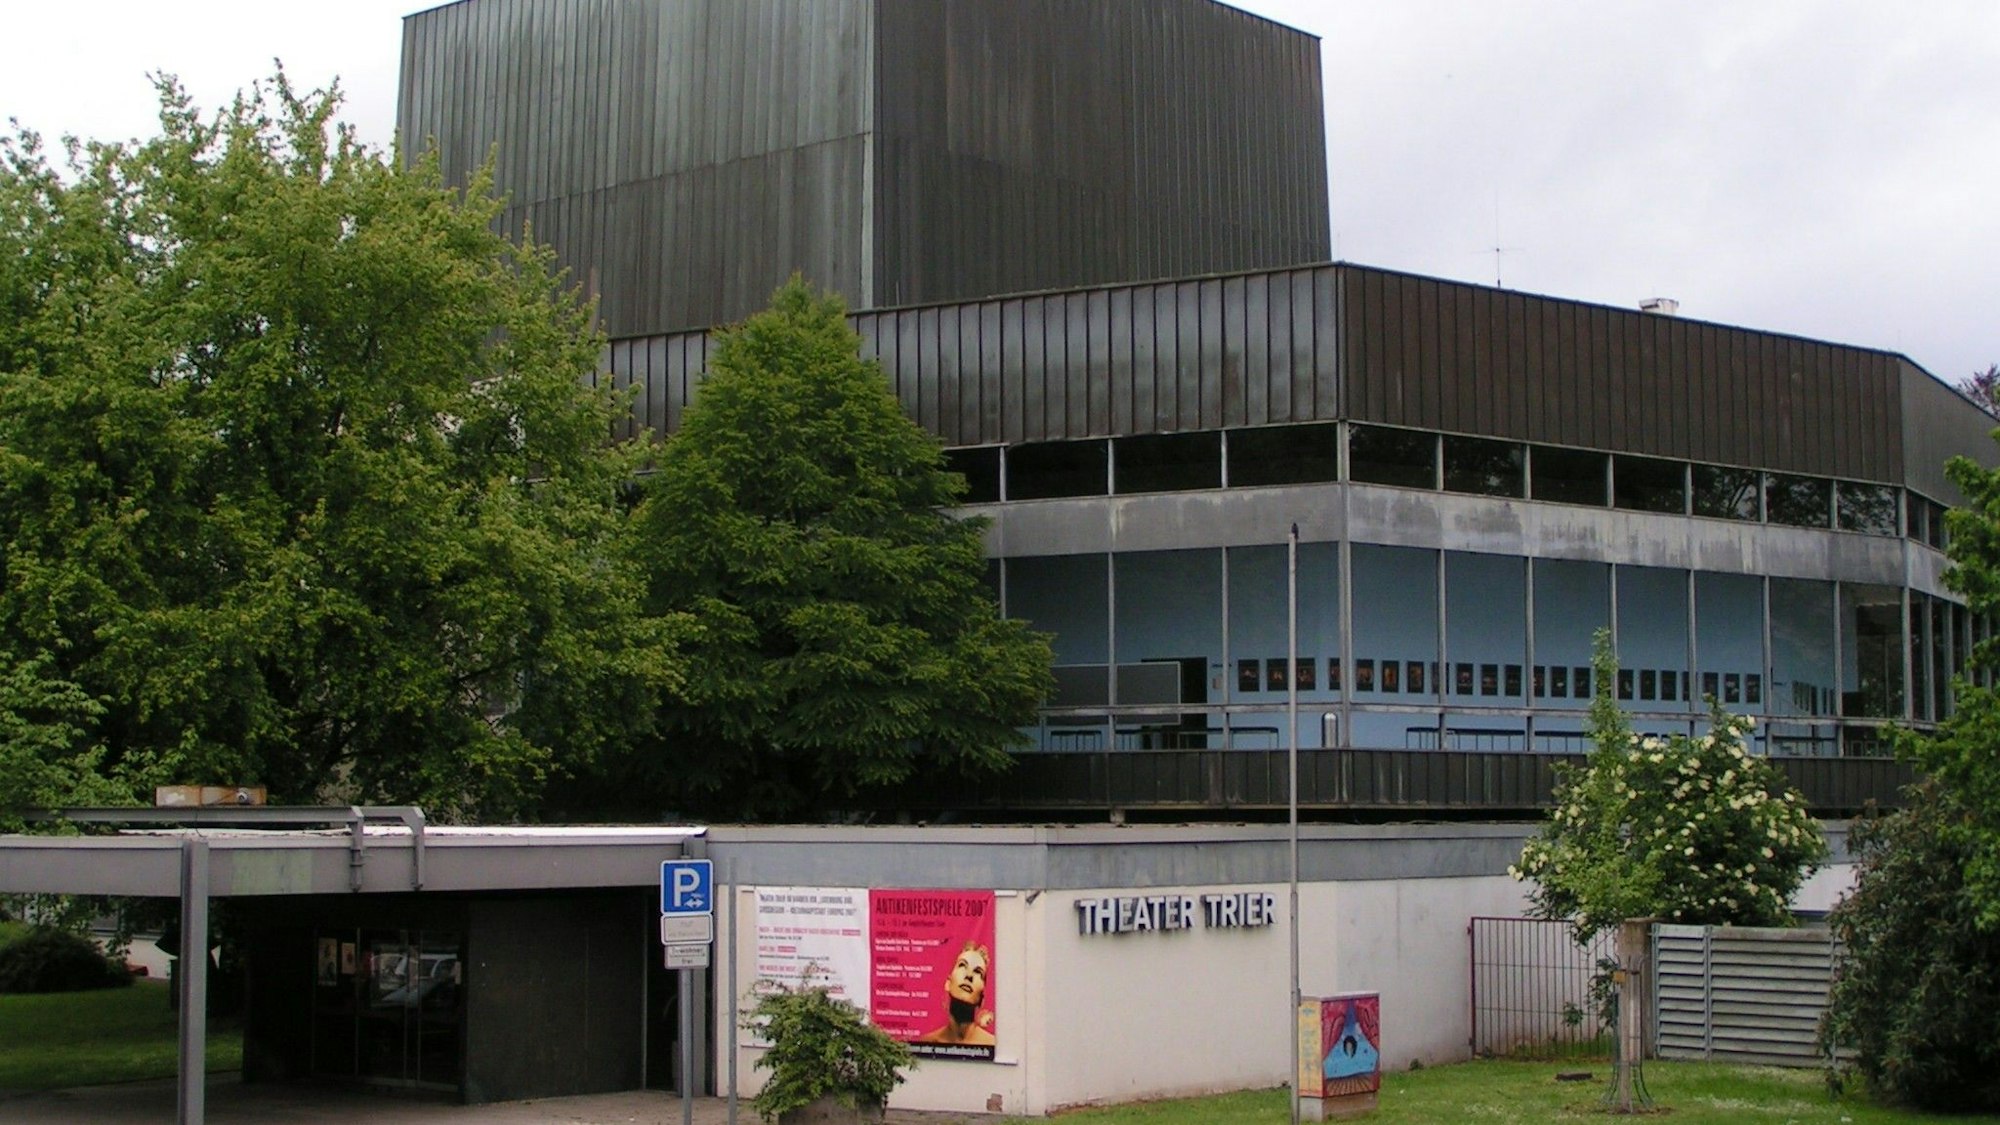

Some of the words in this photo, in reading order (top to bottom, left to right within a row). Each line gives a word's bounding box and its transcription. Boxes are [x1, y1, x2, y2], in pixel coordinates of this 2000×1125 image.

[674, 868, 700, 907] P
[876, 898, 962, 916] ANTIKENFESTSPIELE
[965, 899, 988, 917] 2007
[1079, 896, 1195, 934] THEATER
[1205, 893, 1276, 928] TRIER
